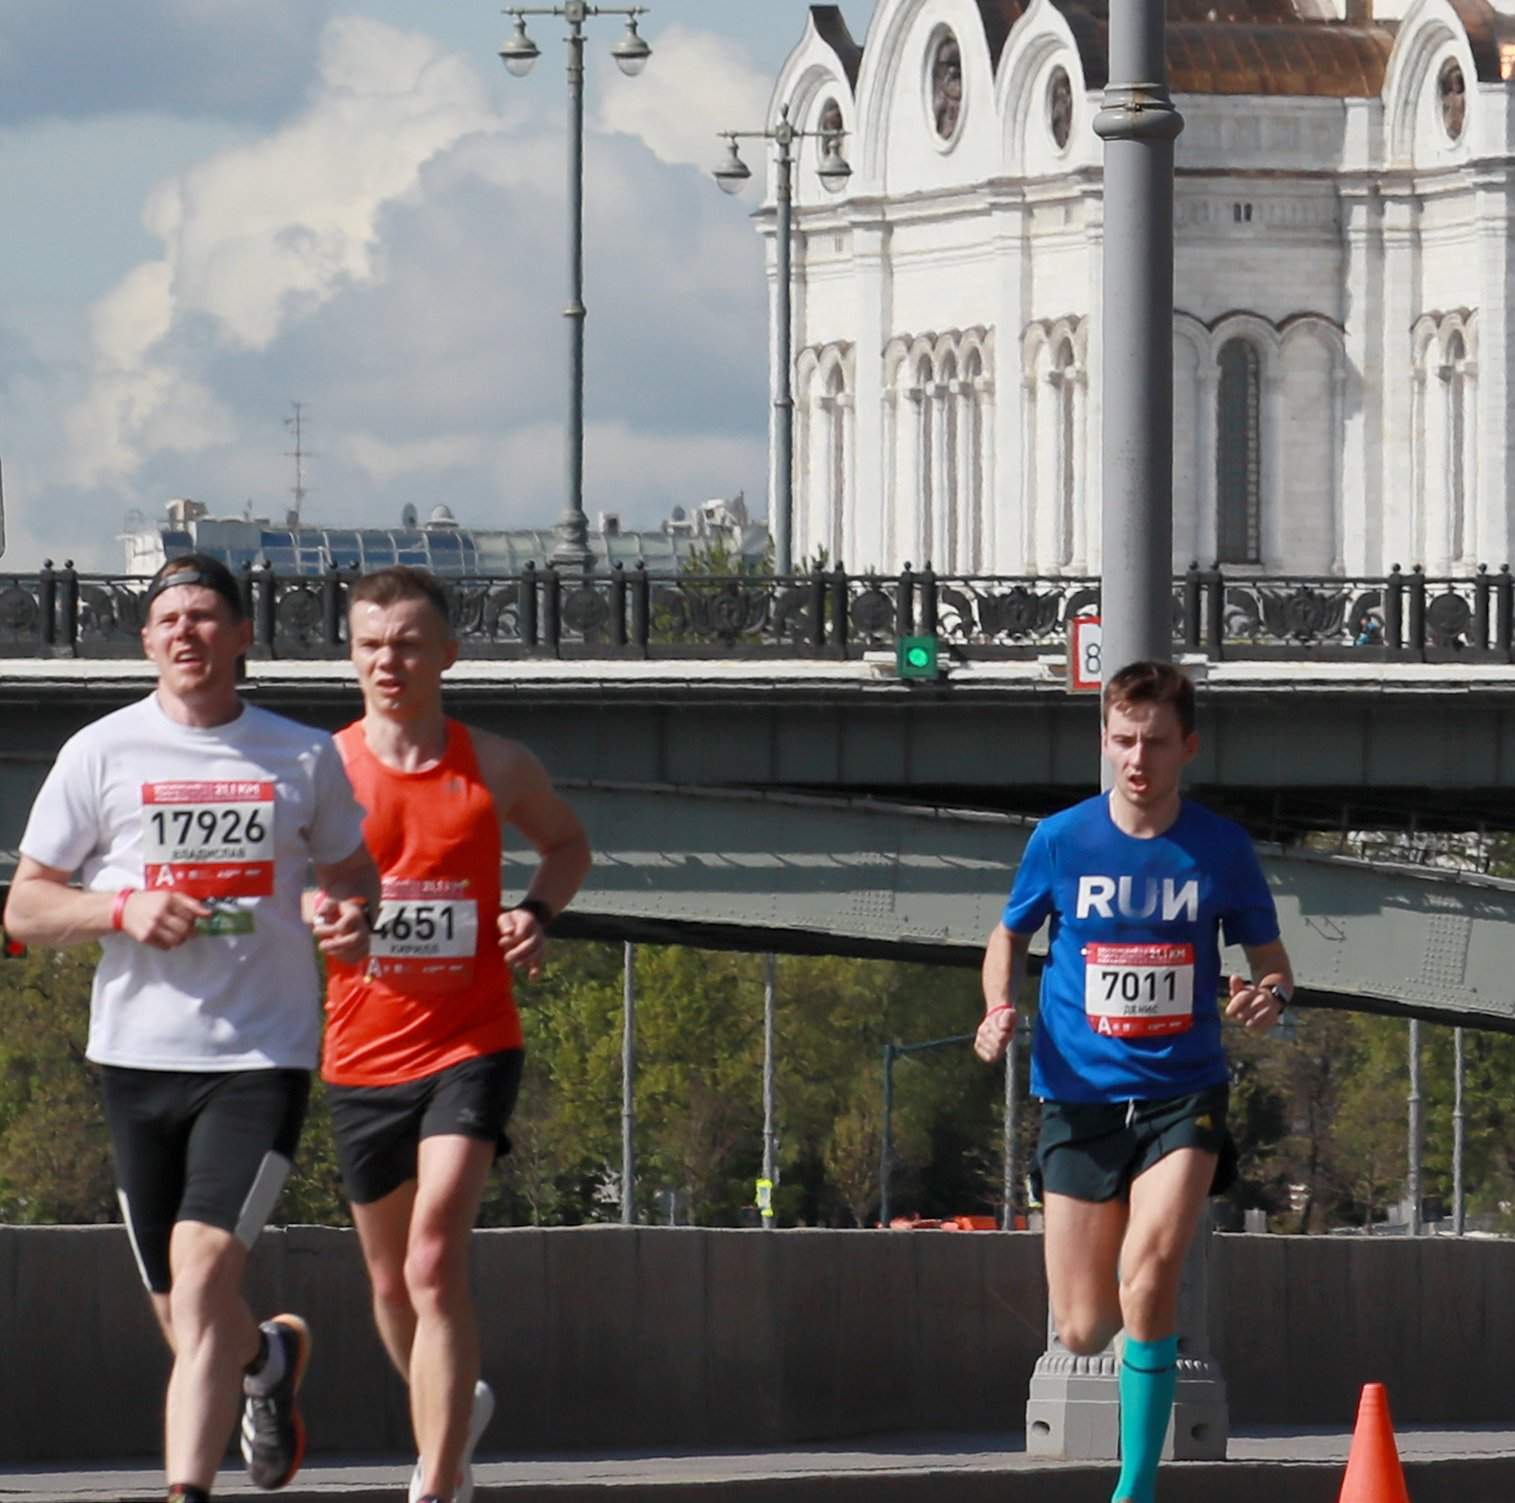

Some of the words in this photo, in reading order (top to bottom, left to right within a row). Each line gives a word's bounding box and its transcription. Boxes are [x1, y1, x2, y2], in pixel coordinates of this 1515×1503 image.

[151, 809, 265, 845] 17926
[155, 864, 175, 887] A
[1101, 971, 1177, 1002] 7011
